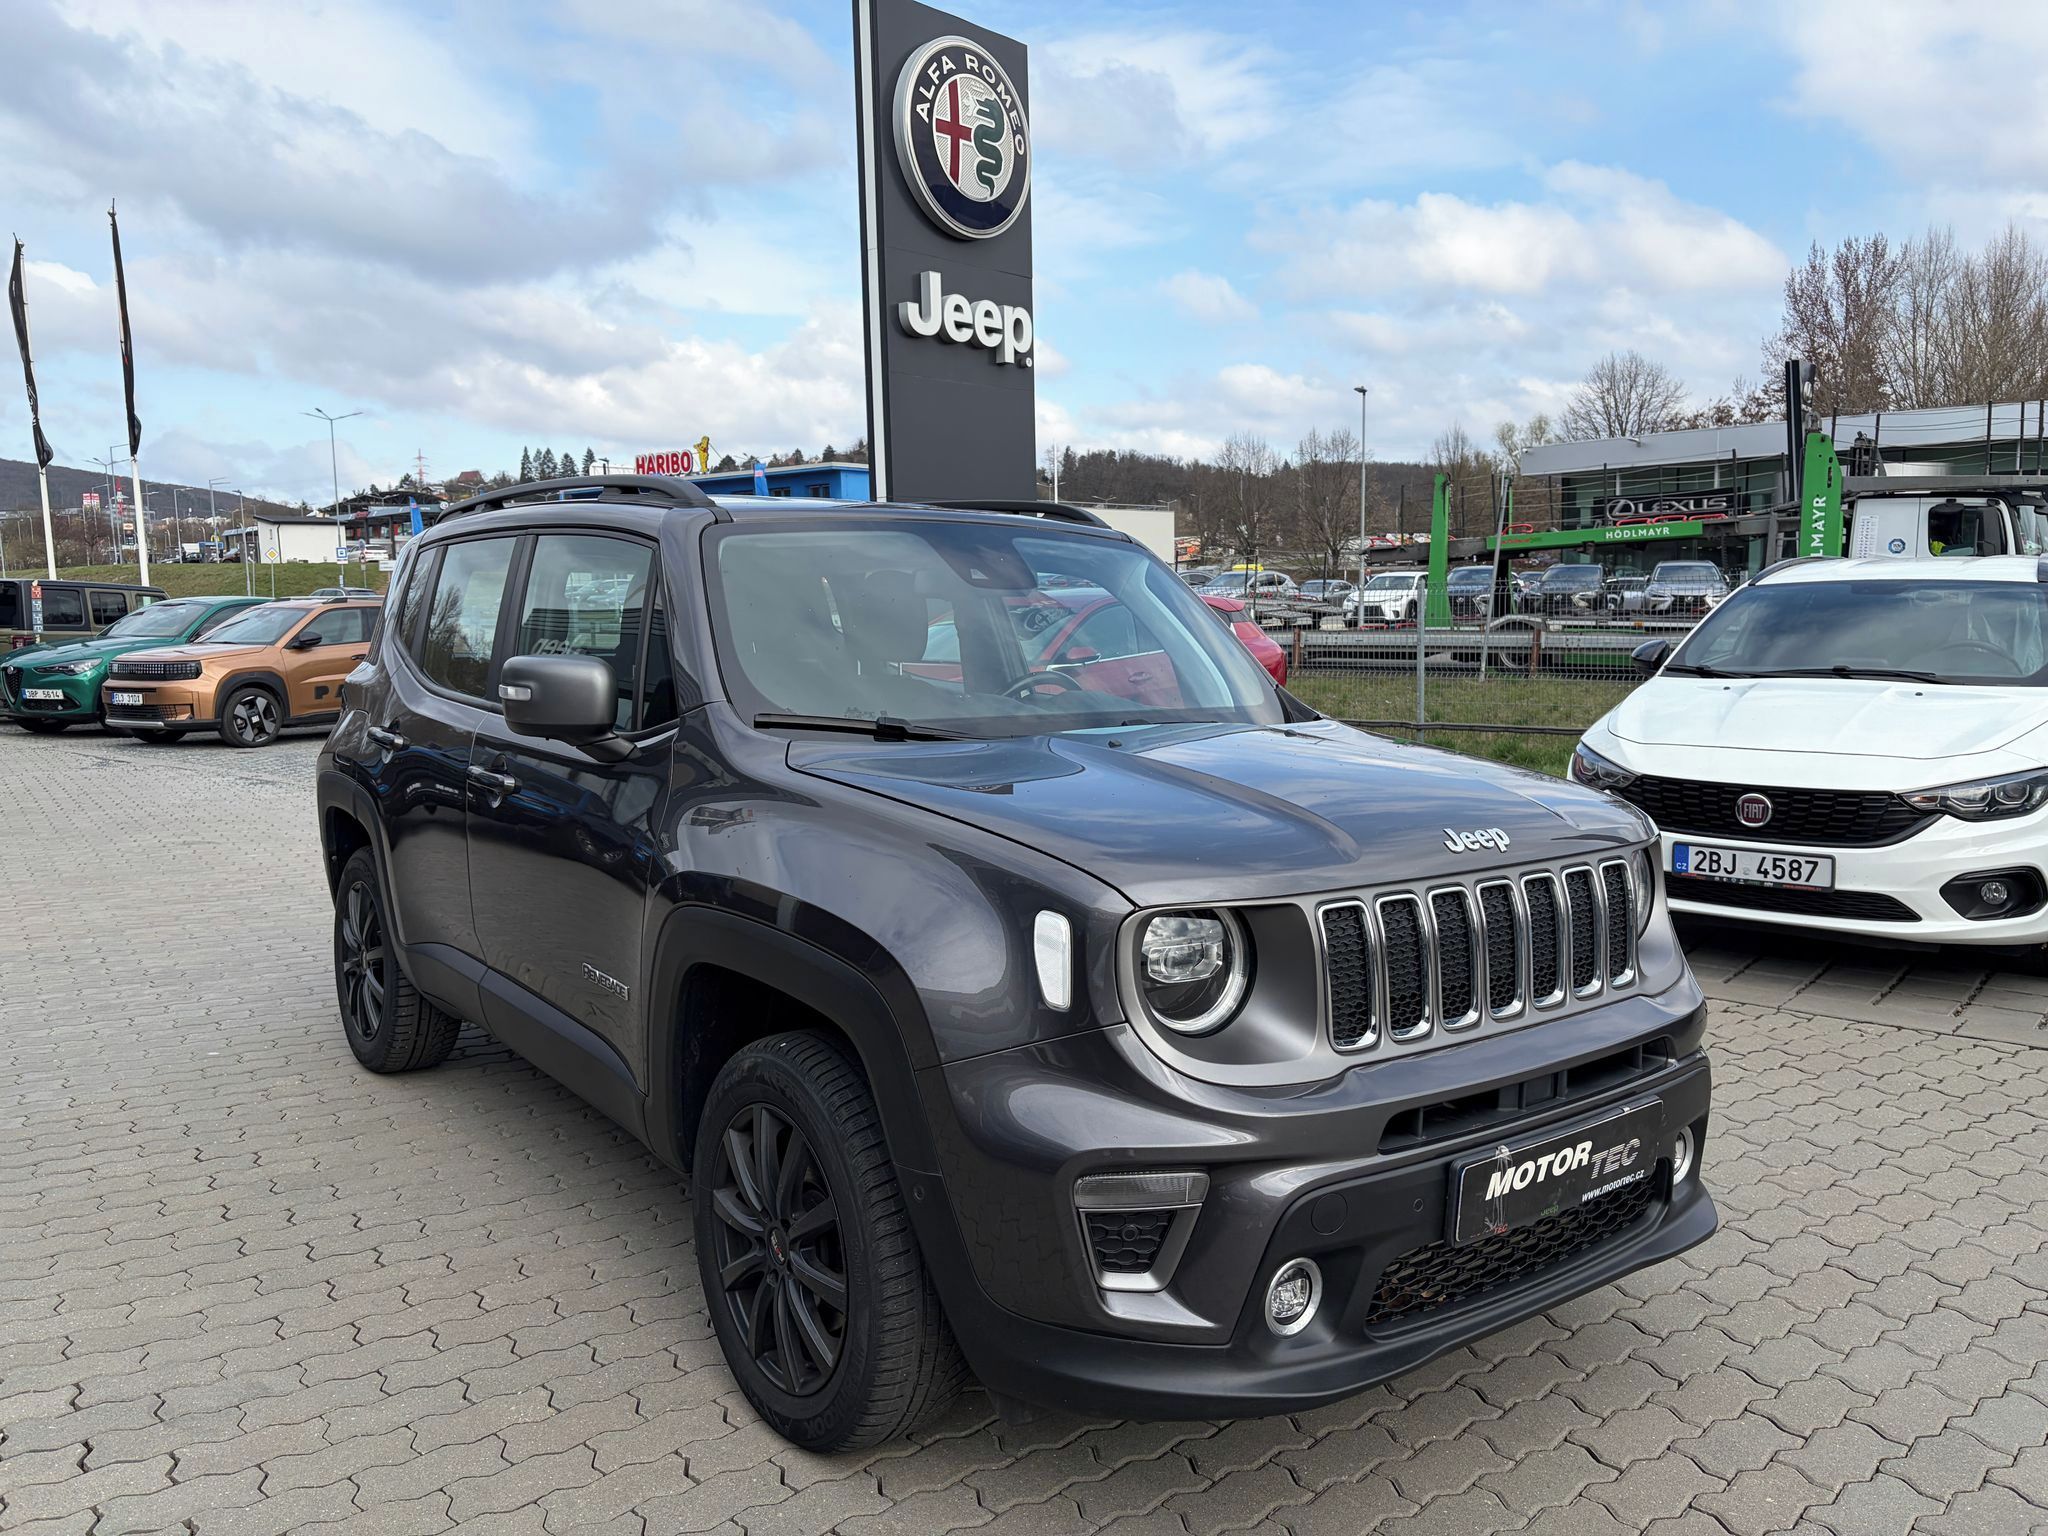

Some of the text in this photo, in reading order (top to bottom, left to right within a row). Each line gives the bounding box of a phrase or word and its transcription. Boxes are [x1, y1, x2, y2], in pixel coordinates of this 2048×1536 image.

[915, 52, 1026, 157] ALFA ROMEO
[898, 271, 1033, 365] Jeep
[635, 449, 694, 476] HARIBO
[1637, 496, 1728, 515] LEXUS
[1605, 526, 1671, 540] HÖDLMAYR
[1743, 802, 1765, 819] FIAT
[1442, 827, 1511, 854] Jeep
[1676, 862, 1688, 871] CZ
[1694, 850, 1819, 883] 2BJ 4587
[1581, 1168, 1645, 1202] www.motortec.cz
